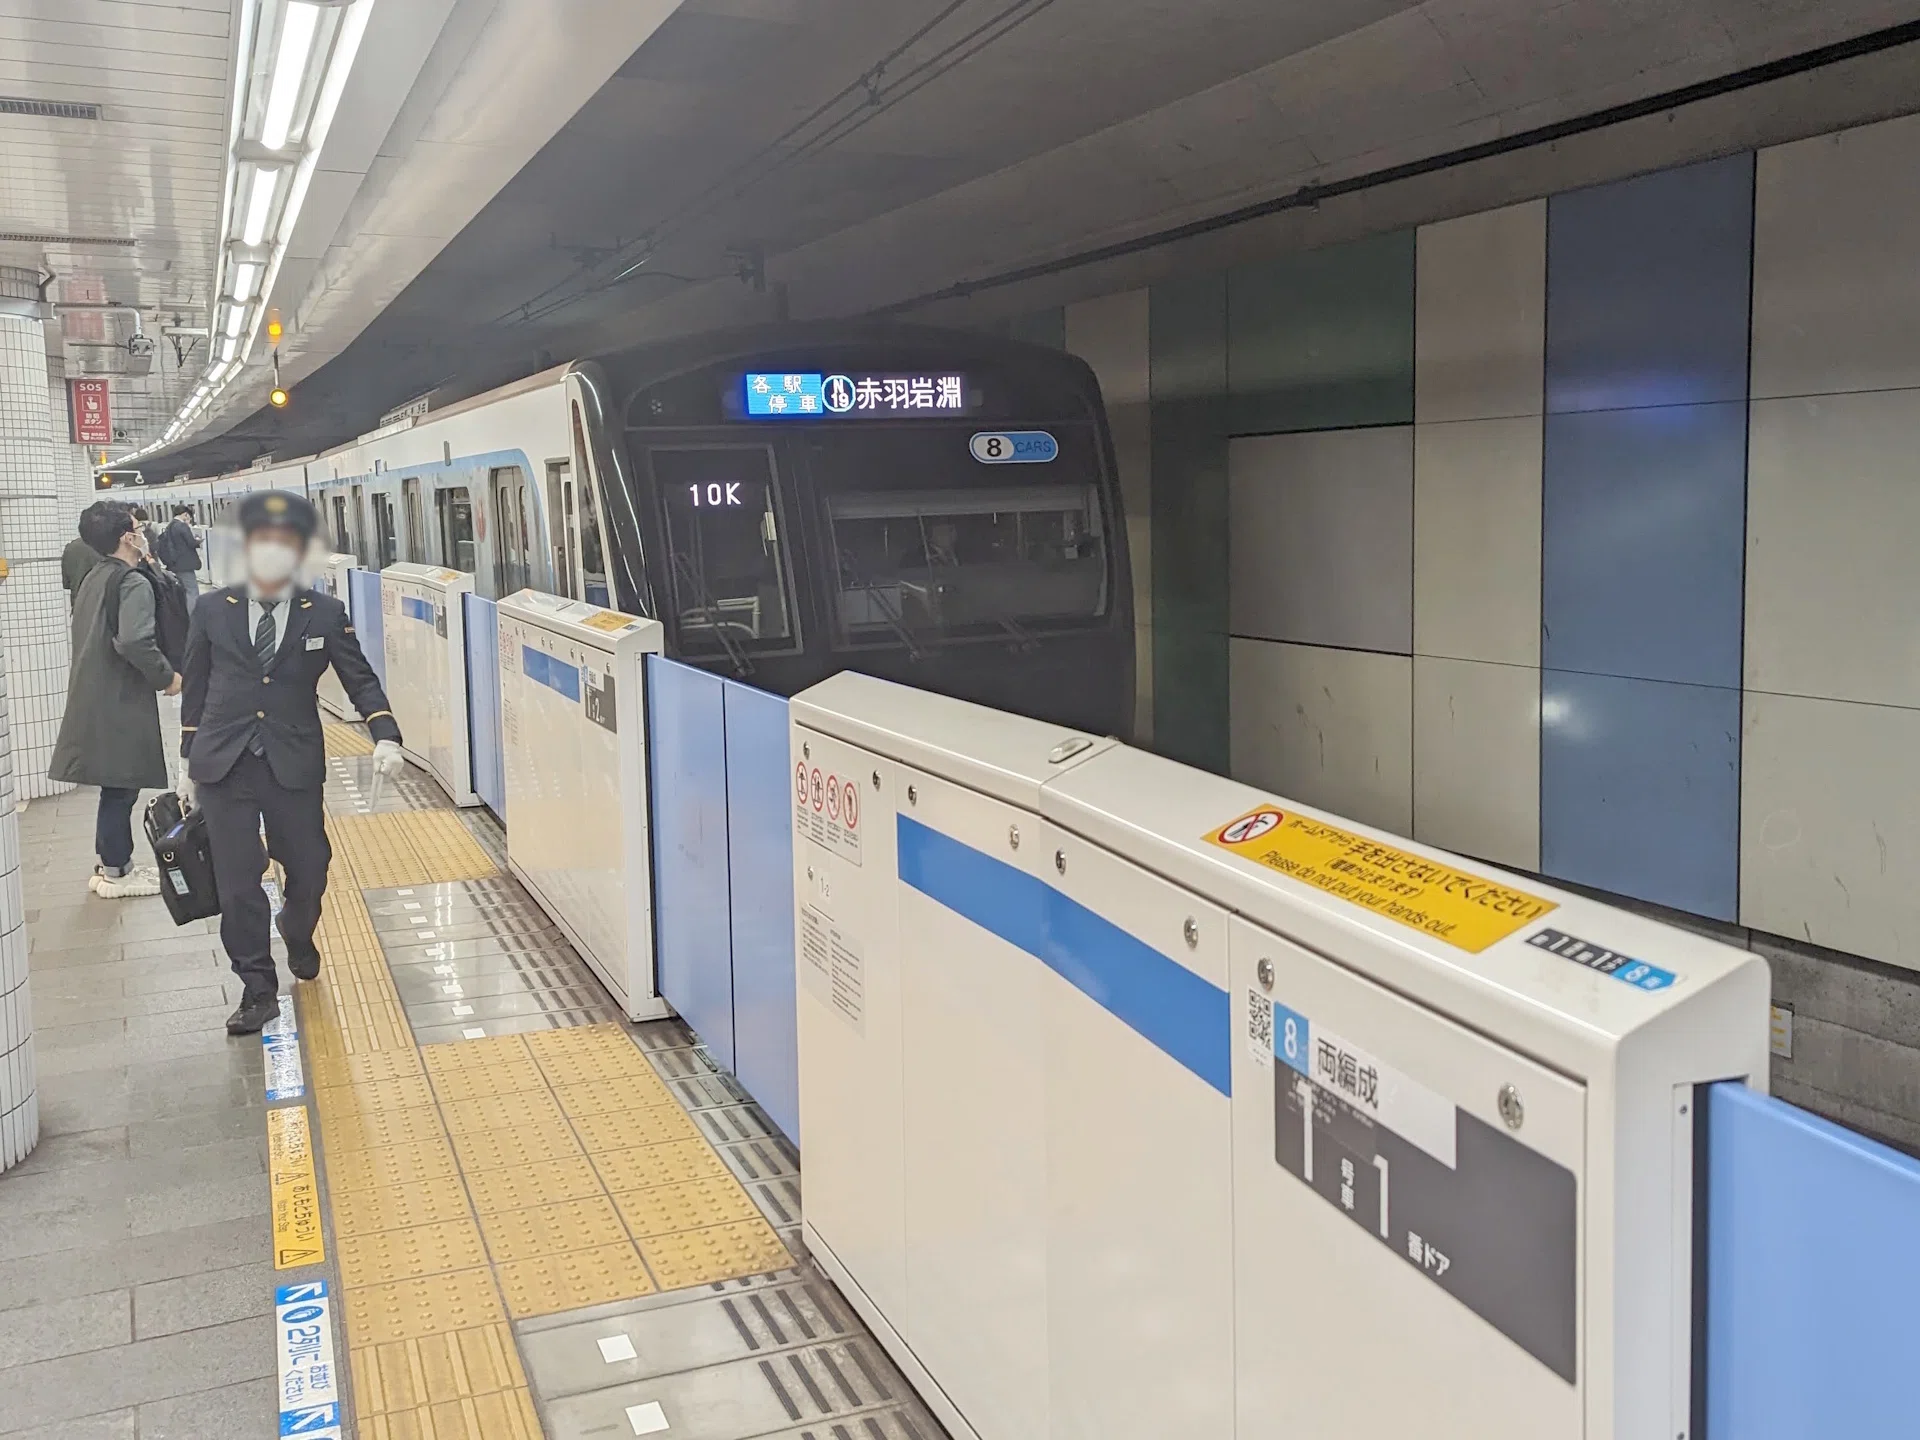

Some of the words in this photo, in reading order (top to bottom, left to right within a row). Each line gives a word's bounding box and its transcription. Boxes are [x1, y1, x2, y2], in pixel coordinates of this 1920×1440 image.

[79, 383, 102, 391] SOS
[752, 375, 803, 394] 各駅
[833, 378, 844, 393] N
[856, 376, 962, 410] 赤羽岩淵
[768, 394, 819, 414] 停車
[831, 393, 849, 408] 19
[987, 437, 1002, 458] 8
[1015, 440, 1052, 454] CARS
[689, 482, 742, 507] 10K
[1258, 849, 1301, 873] Please
[1295, 865, 1318, 880] do
[1313, 873, 1341, 889] not
[1326, 880, 1360, 897] put
[1347, 889, 1388, 908] your
[1379, 899, 1430, 925] hands
[1284, 1017, 1298, 1059] 8
[1316, 1036, 1380, 1111] 両編成
[292, 1183, 316, 1242] あしもとちゅうい
[287, 1325, 323, 1366] 2列に
[284, 1369, 305, 1404] ください
